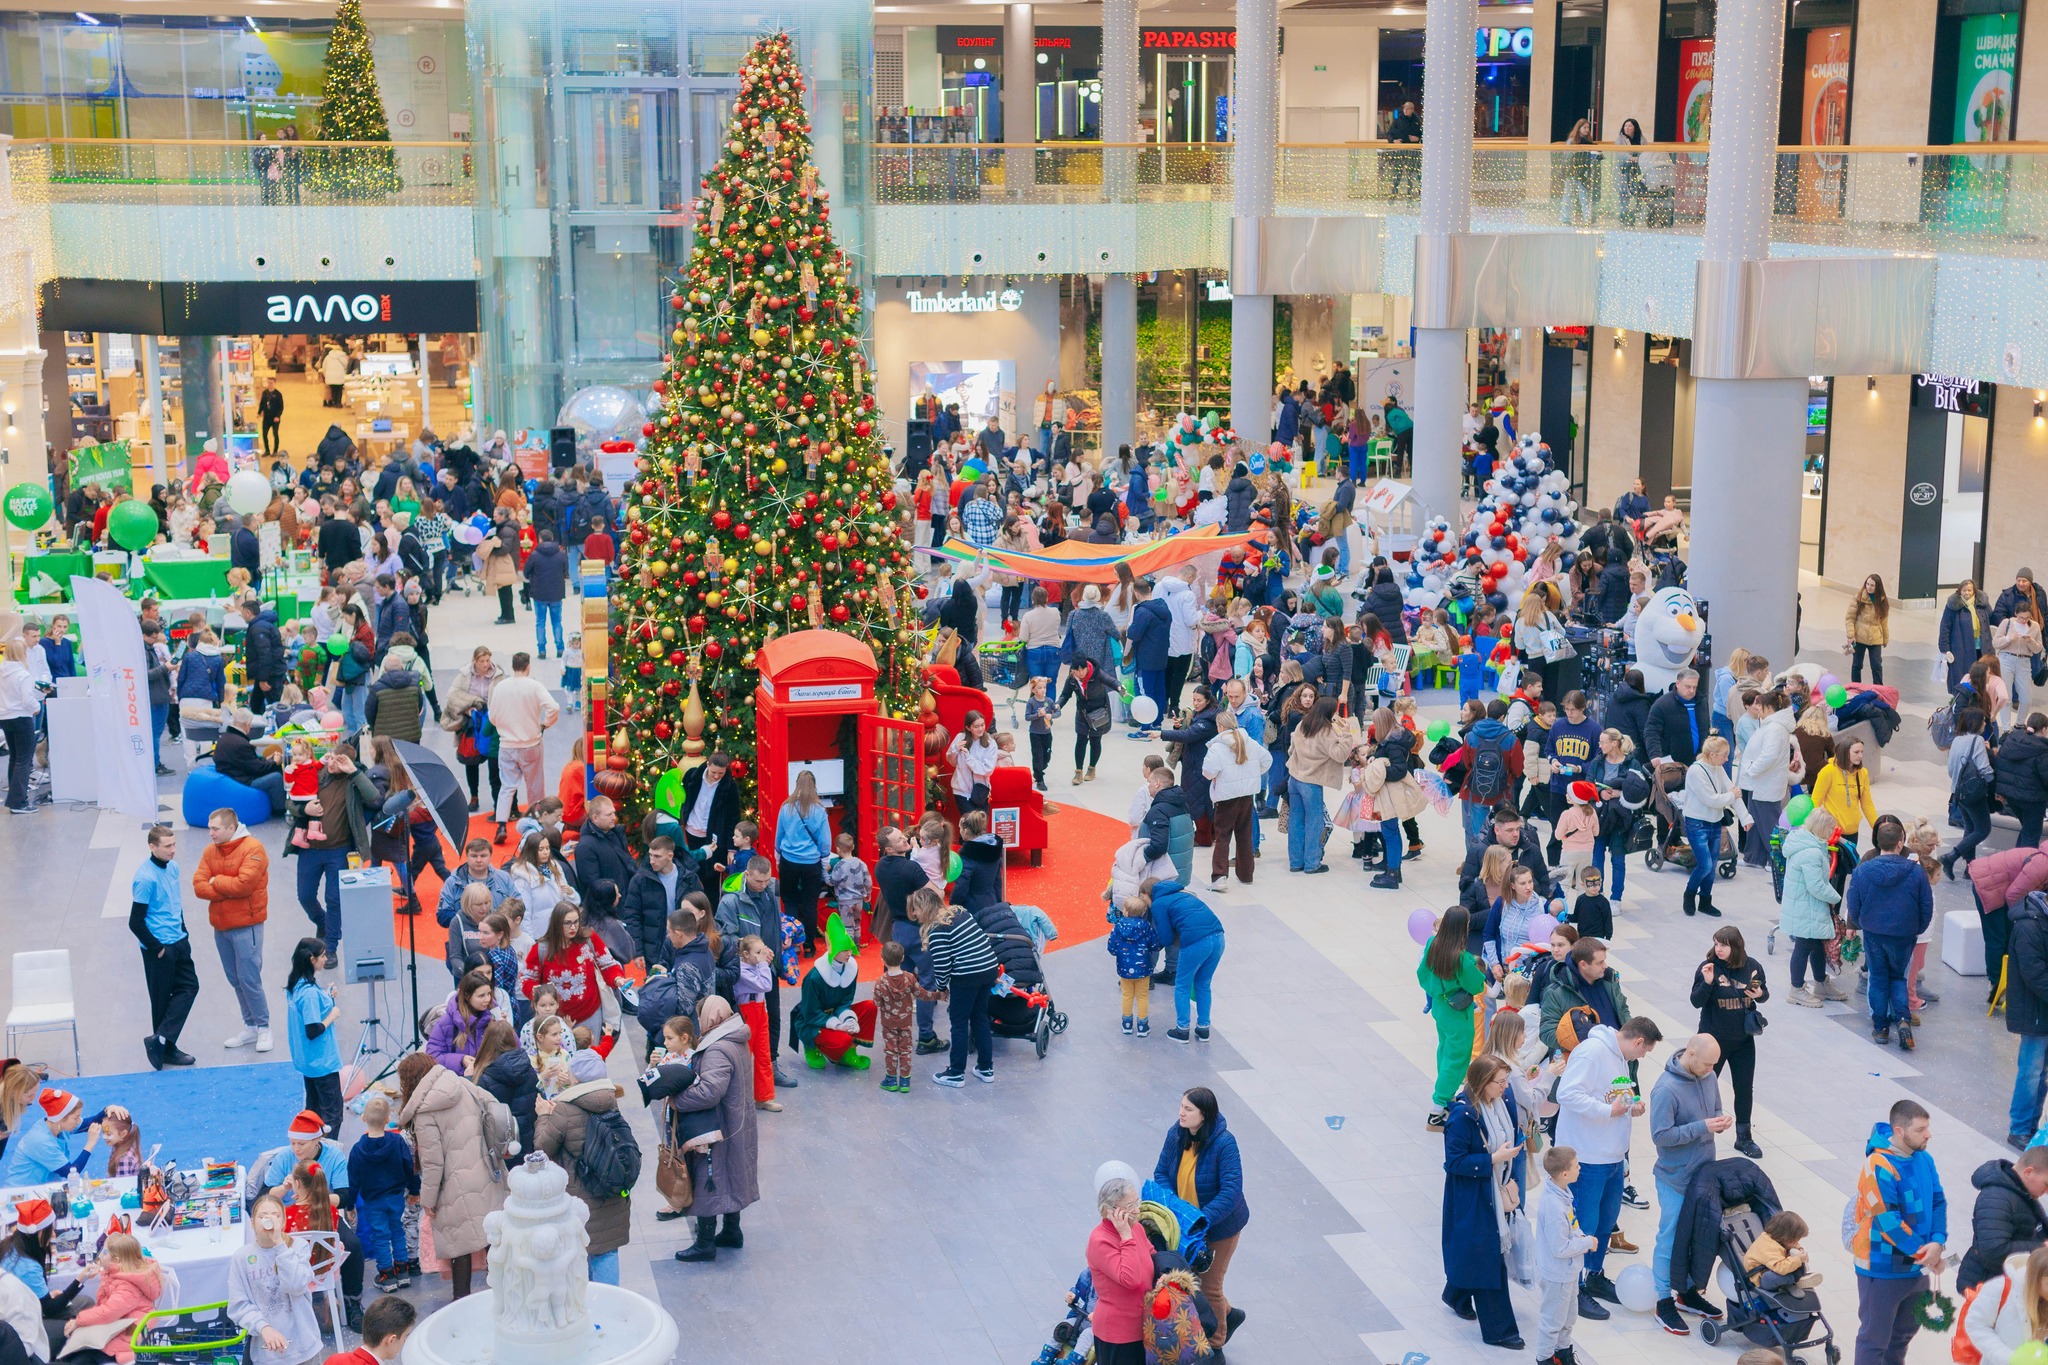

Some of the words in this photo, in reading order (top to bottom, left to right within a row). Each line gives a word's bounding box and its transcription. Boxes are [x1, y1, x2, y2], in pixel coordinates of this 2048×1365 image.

[957, 37, 996, 47] БОУЛІНГ
[906, 290, 998, 313] Timberland
[380, 294, 392, 322] max
[111, 468, 125, 478] YEAR
[9, 497, 37, 505] HAPPY
[9, 503, 38, 511] NOVUS
[13, 508, 35, 517] YEAR
[1556, 738, 1590, 761] OHIO
